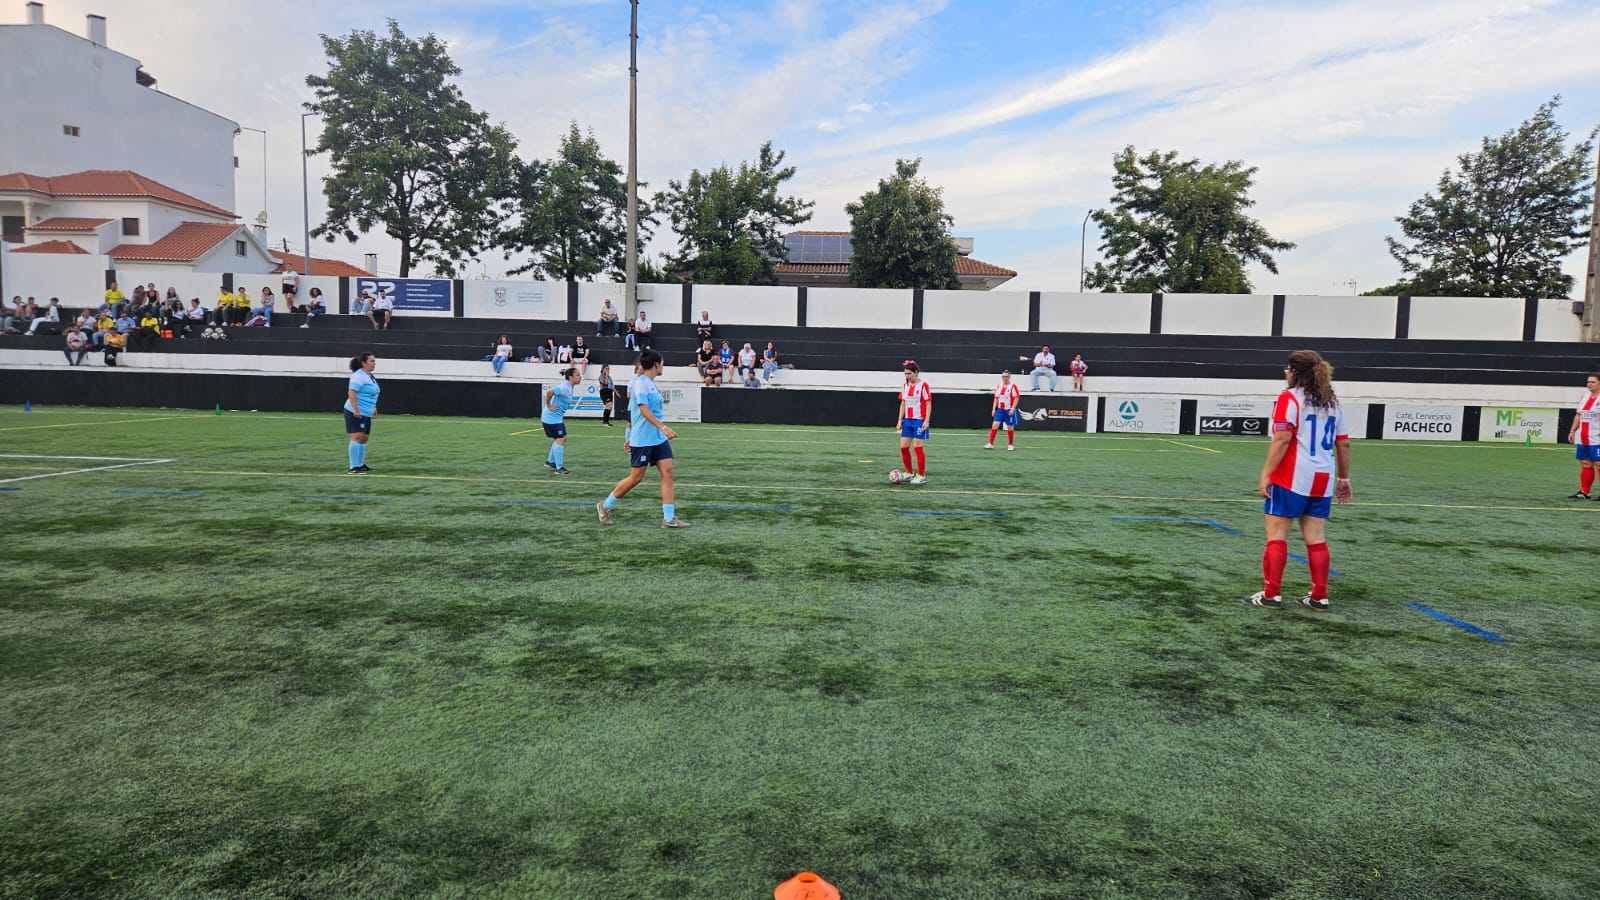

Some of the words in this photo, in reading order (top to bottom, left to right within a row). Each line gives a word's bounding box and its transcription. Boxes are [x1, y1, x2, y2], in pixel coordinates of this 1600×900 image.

[1415, 412, 1452, 422] Cervejaria
[1495, 410, 1524, 426] MF
[1520, 419, 1543, 428] Grupo
[1394, 421, 1452, 433] PACHECO
